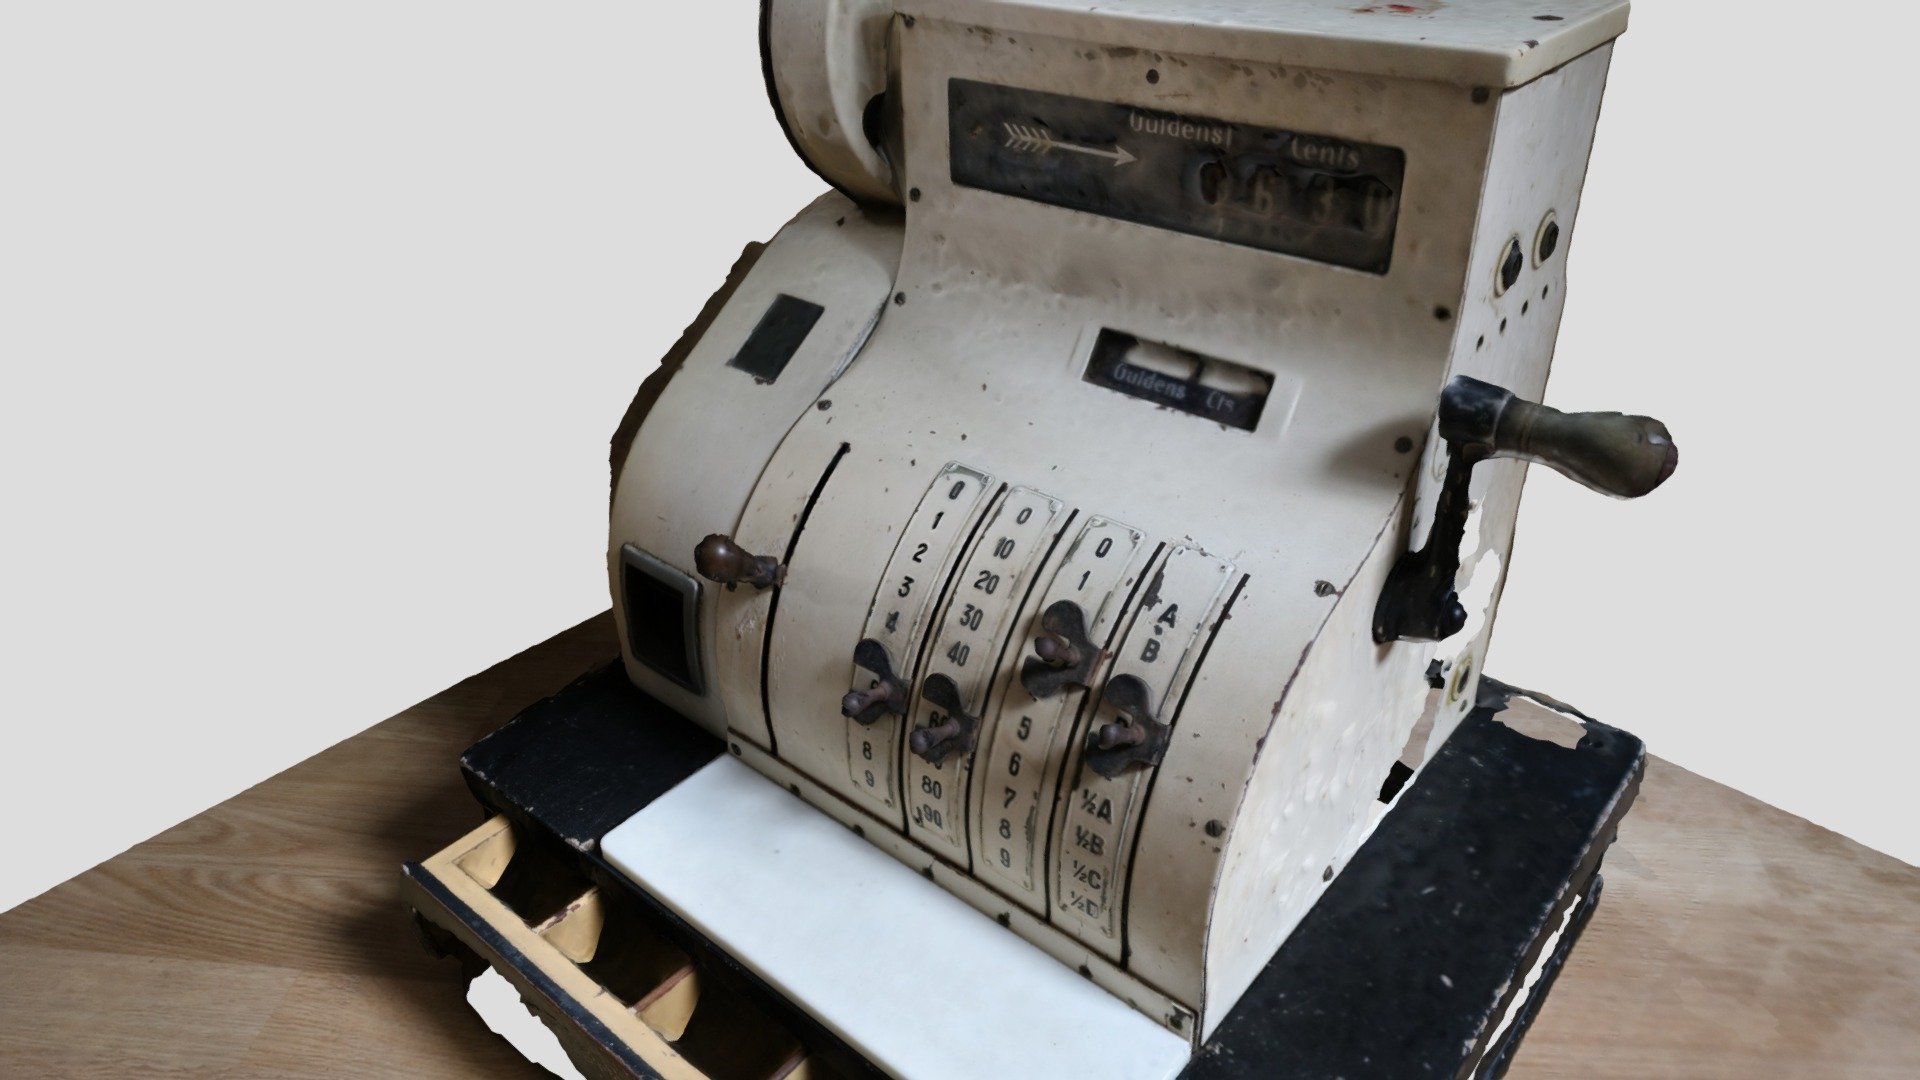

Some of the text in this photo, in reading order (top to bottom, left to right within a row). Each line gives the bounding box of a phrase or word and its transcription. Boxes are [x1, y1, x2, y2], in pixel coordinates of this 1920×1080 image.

[1113, 362, 1187, 399] Guldens
[948, 481, 966, 500] 0
[932, 511, 944, 530] 1
[1016, 507, 1033, 525] 0
[911, 543, 928, 563] 2
[992, 536, 1016, 560] 10
[1094, 537, 1113, 558] 0
[897, 576, 915, 597] 3
[973, 570, 1000, 595] 20
[1077, 570, 1091, 591] 1
[884, 610, 900, 634] 4
[959, 603, 984, 632] 30
[1156, 603, 1179, 629] A
[947, 640, 971, 667] 40
[1139, 637, 1161, 663] B
[1016, 716, 1033, 741] 5
[862, 740, 873, 761] 8
[1007, 752, 1022, 777] 6
[864, 769, 875, 788] 9
[921, 775, 943, 800] 80
[1003, 787, 1017, 810] 7
[998, 818, 1012, 840] 8
[999, 848, 1012, 868] 9
